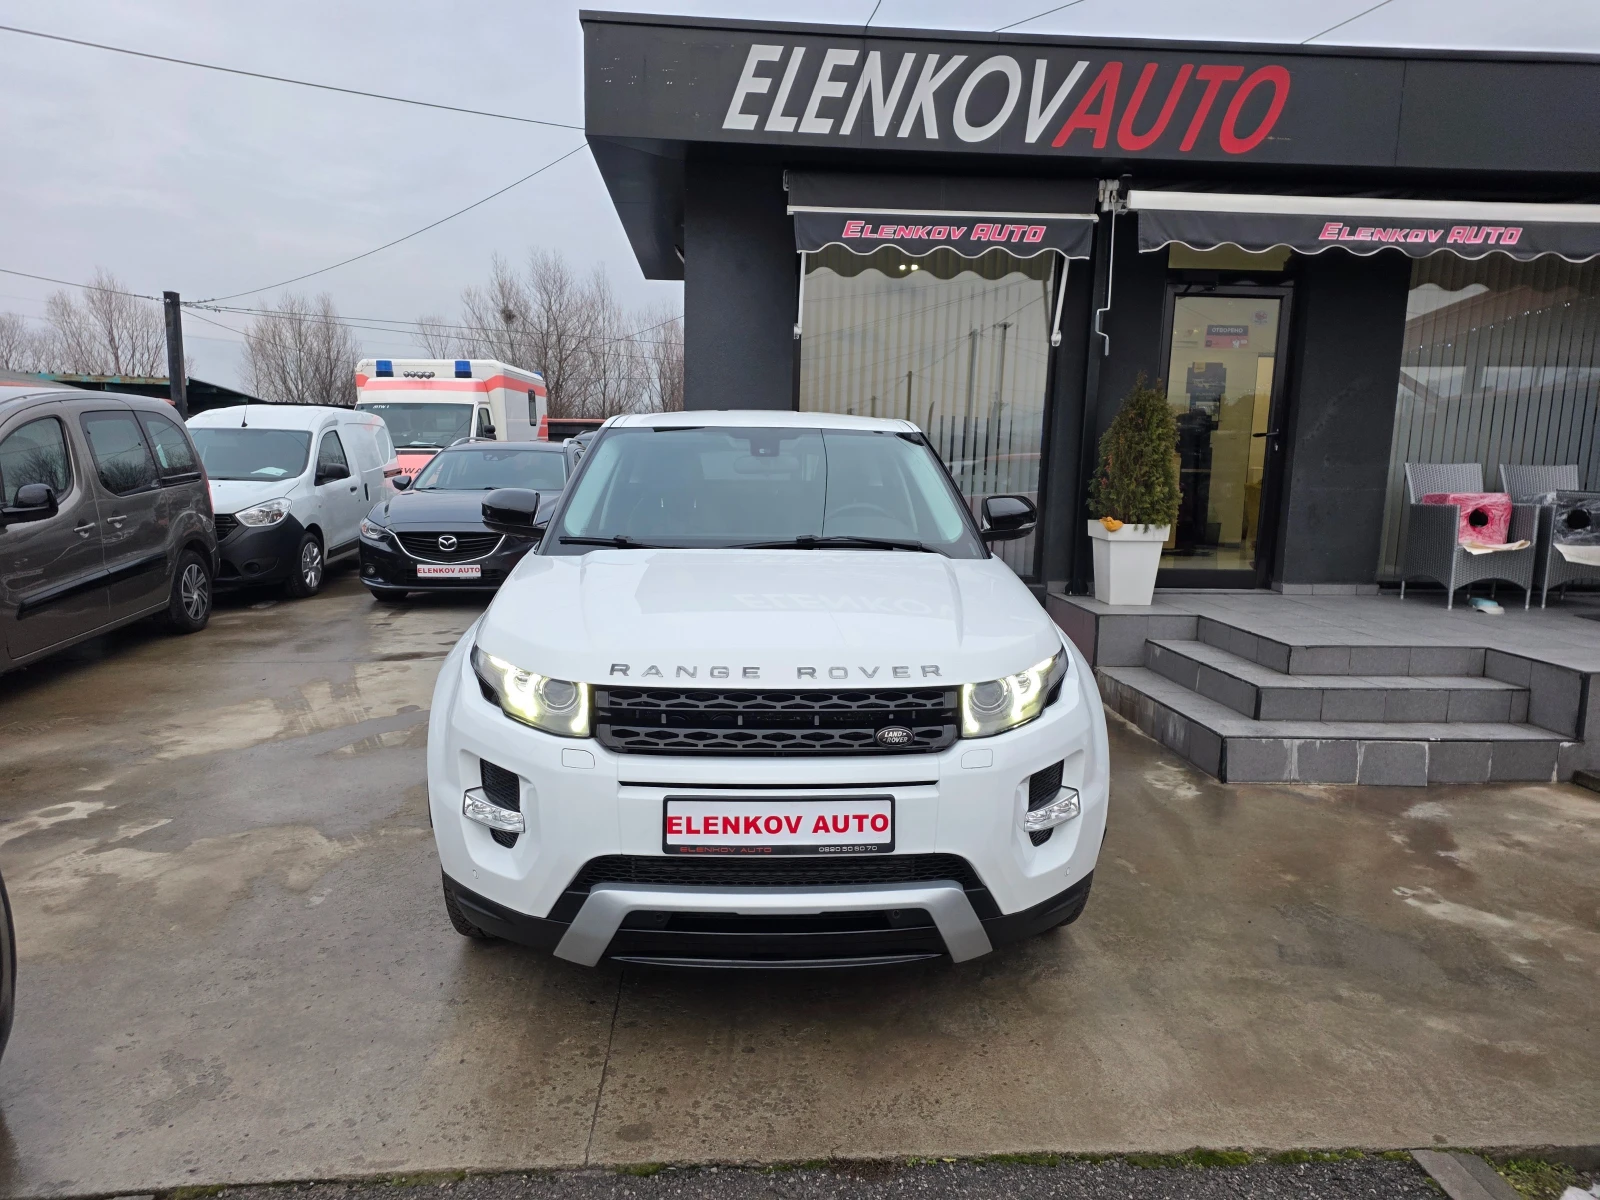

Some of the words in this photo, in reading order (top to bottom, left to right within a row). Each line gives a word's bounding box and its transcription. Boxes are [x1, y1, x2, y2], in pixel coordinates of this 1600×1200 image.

[970, 223, 1047, 243] AUTO
[1447, 225, 1523, 245] AUTO
[609, 663, 761, 679] RANGE
[796, 664, 942, 679] ROVER
[667, 815, 803, 835] ELENKOV
[812, 813, 889, 834] AUTO
